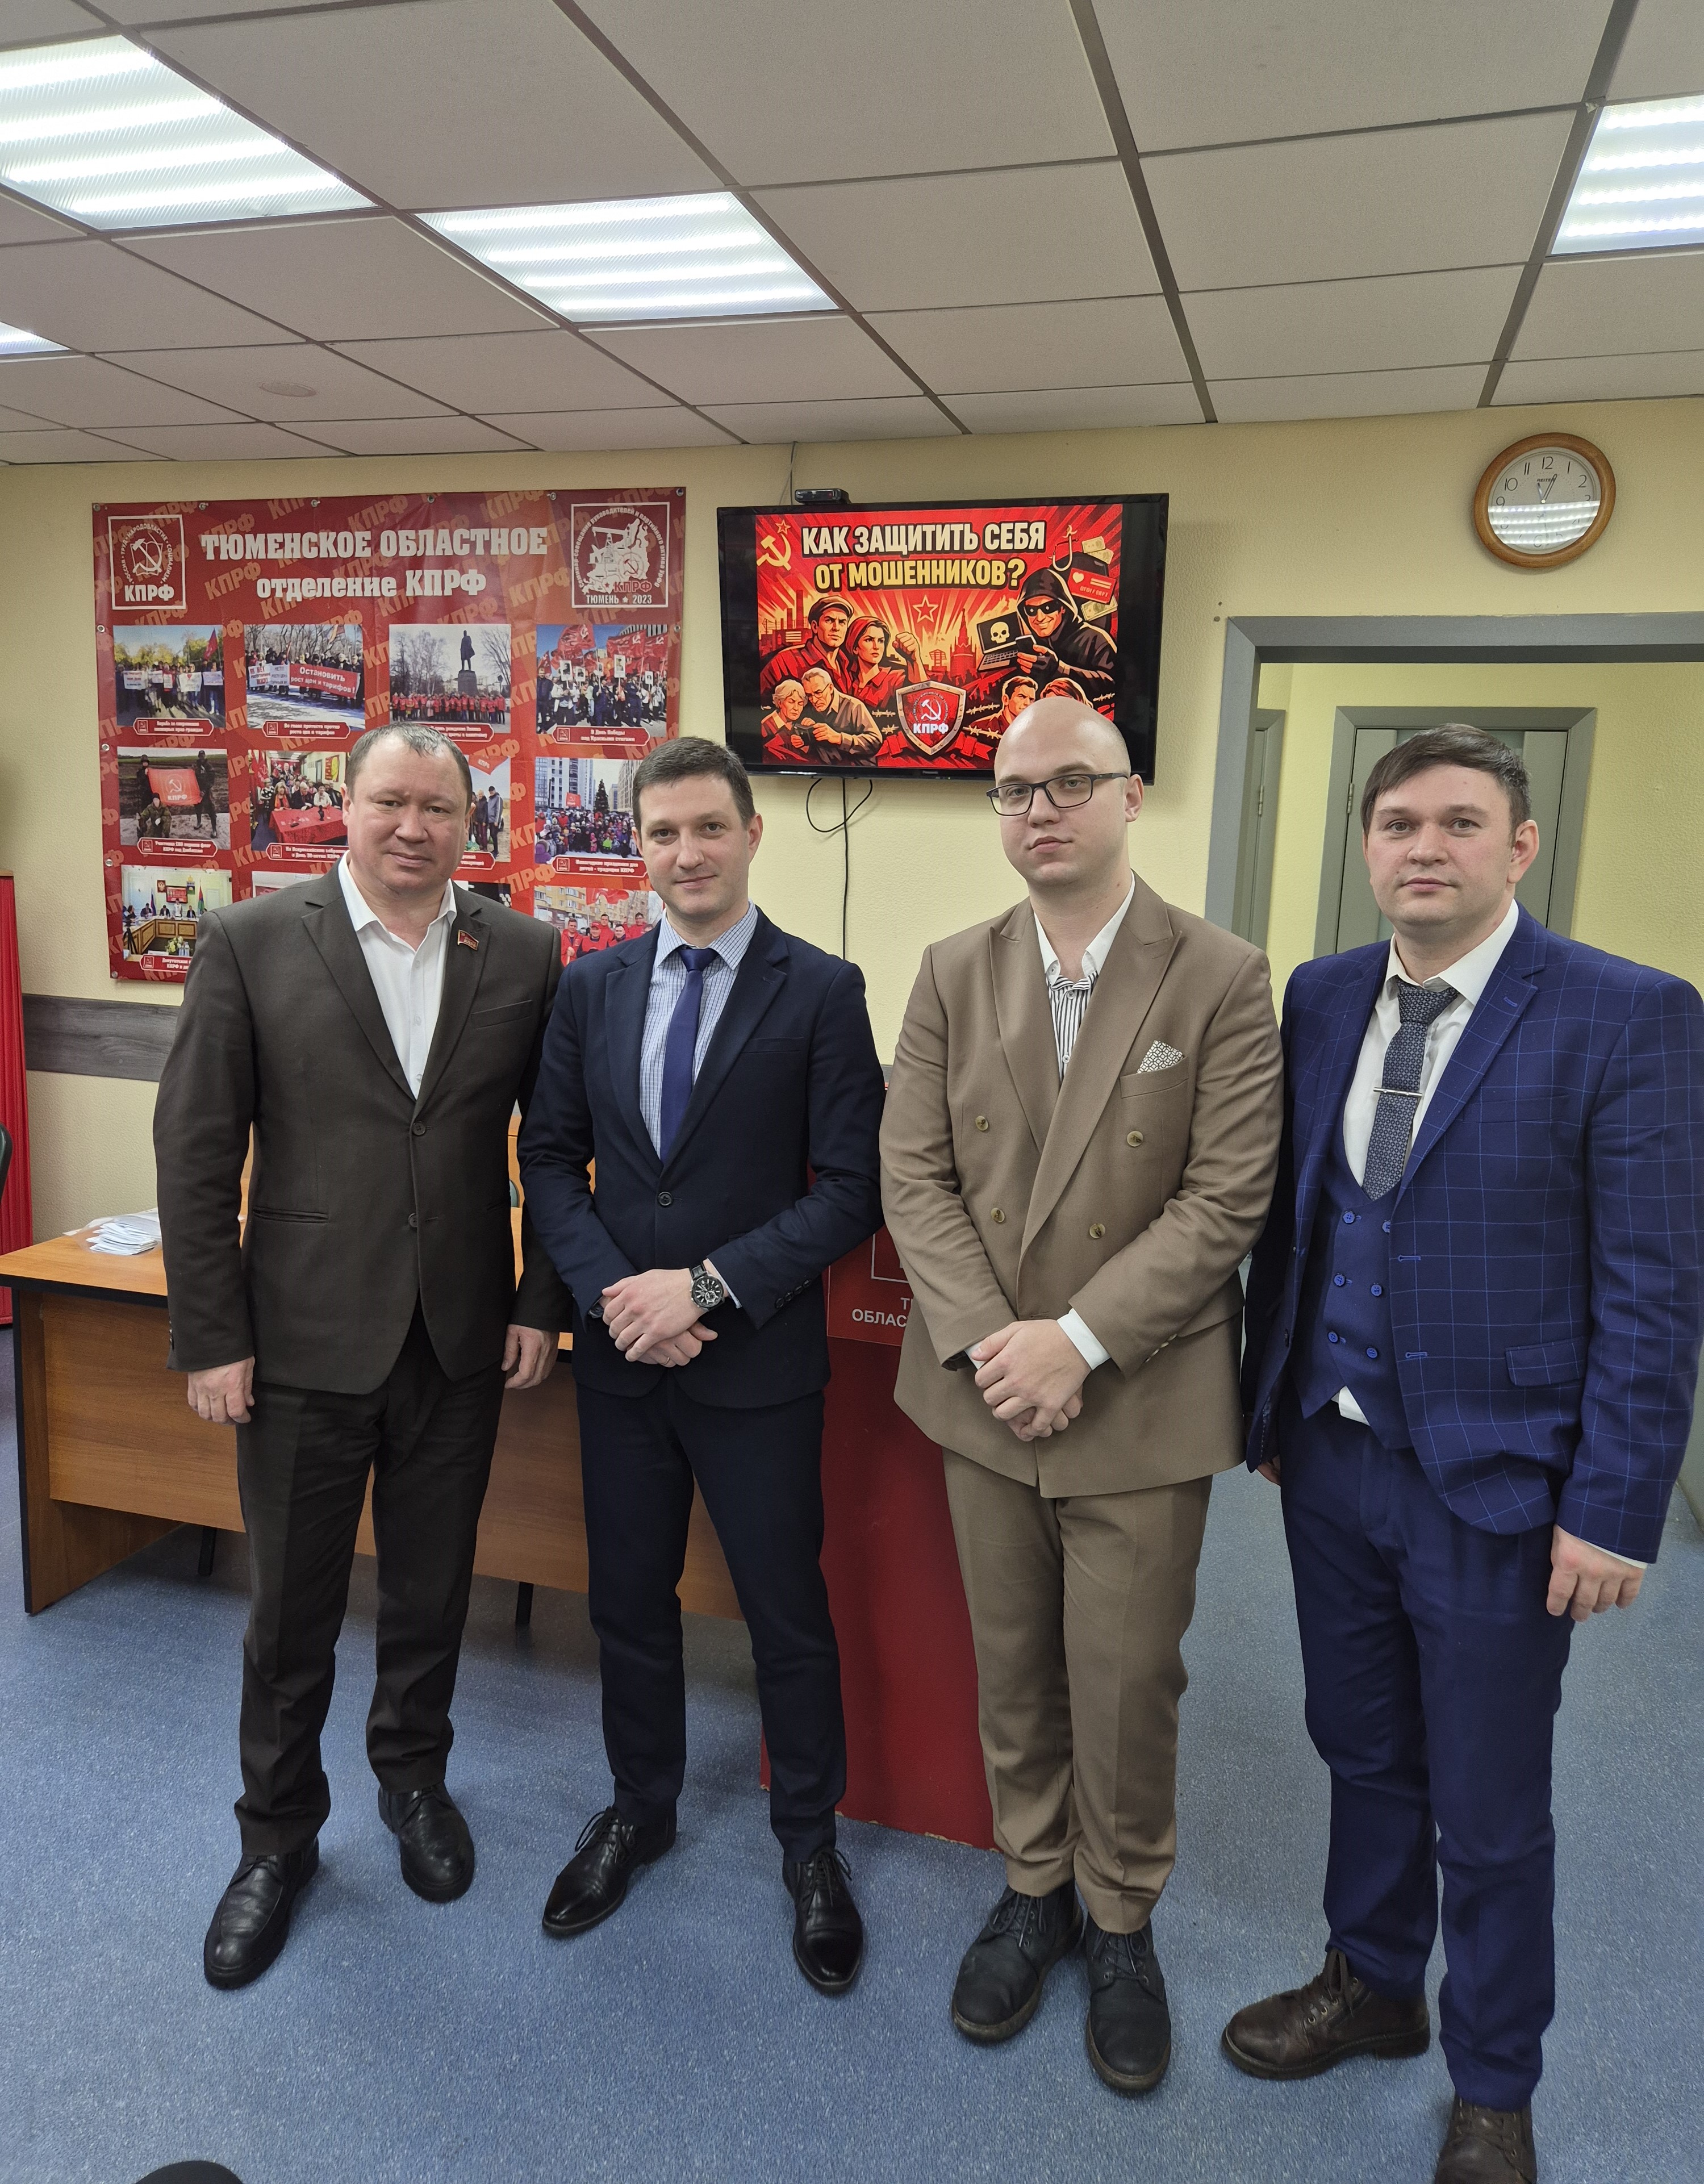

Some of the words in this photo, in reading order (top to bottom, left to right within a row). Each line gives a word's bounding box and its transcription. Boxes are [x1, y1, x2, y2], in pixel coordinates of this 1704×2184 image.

[1523, 462, 1531, 475] 11
[1542, 456, 1554, 470] 12
[1567, 461, 1571, 474] 1
[1504, 477, 1518, 491] 10
[1578, 475, 1587, 488] 2
[1496, 496, 1505, 507] 9
[348, 494, 408, 532] КПРФ
[201, 531, 371, 560] ТЮМЕНСКОЕ
[380, 528, 548, 557] ОБЛАСТНОЕ
[803, 527, 850, 555] КАК
[854, 524, 978, 556] ЗАЩИТИТЬ
[984, 521, 1045, 550] СЕБЯ
[127, 523, 168, 542] НАРОДОВЛАСТИЕ
[161, 543, 174, 583] СОЦИАЛИЗМ
[205, 561, 261, 600] КПРФ
[816, 563, 842, 589] ОТ
[849, 558, 1025, 587] МОШЕННИКОВ?
[124, 584, 175, 602] КПРФ
[257, 577, 397, 602] отделение
[406, 569, 487, 596] КПРФ
[509, 567, 570, 607] КПРФ
[613, 581, 653, 593] КПРФ
[586, 595, 619, 604] ТЮМЕНЬ
[632, 595, 652, 604] 2023
[299, 666, 346, 682] Остановить
[323, 682, 352, 693] тарифов
[913, 723, 949, 734] КПРФ
[495, 864, 556, 894] ПРФ
[900, 1297, 912, 1310] Т
[852, 1309, 909, 1327] ОБЛАС
